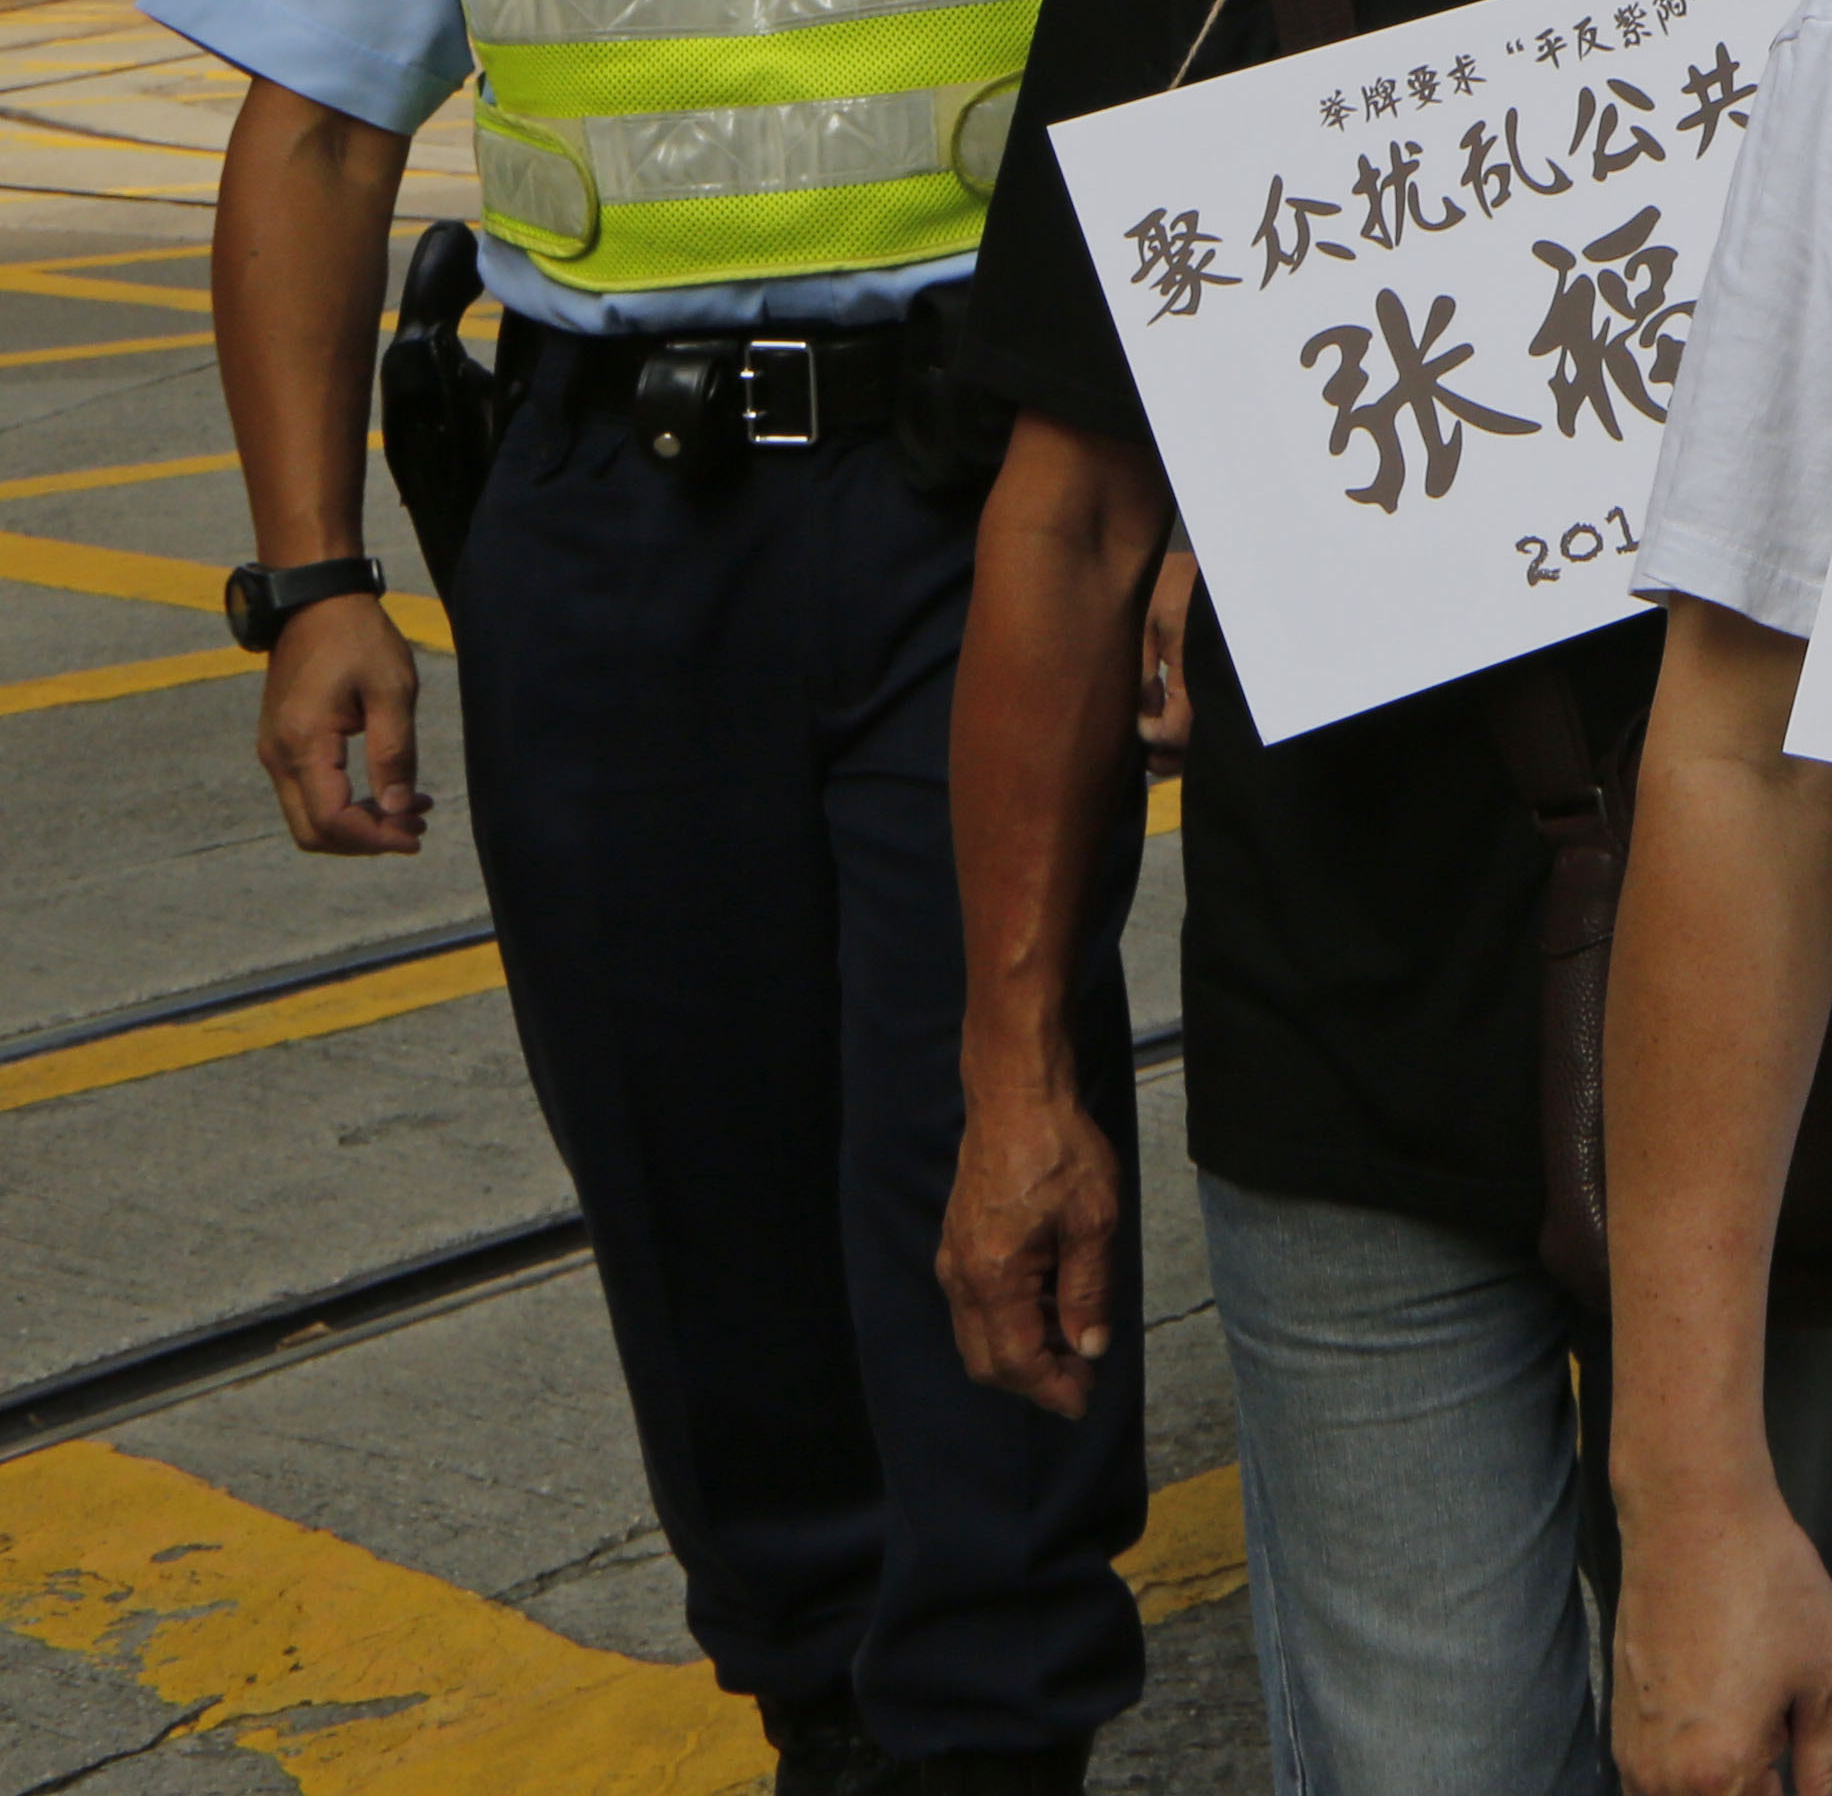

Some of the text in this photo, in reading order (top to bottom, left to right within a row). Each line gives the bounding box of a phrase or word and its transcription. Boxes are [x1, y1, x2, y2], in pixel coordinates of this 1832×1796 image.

[1123, 41, 1759, 326] 聚众扰乱公共
[1299, 204, 1699, 515] 张福
